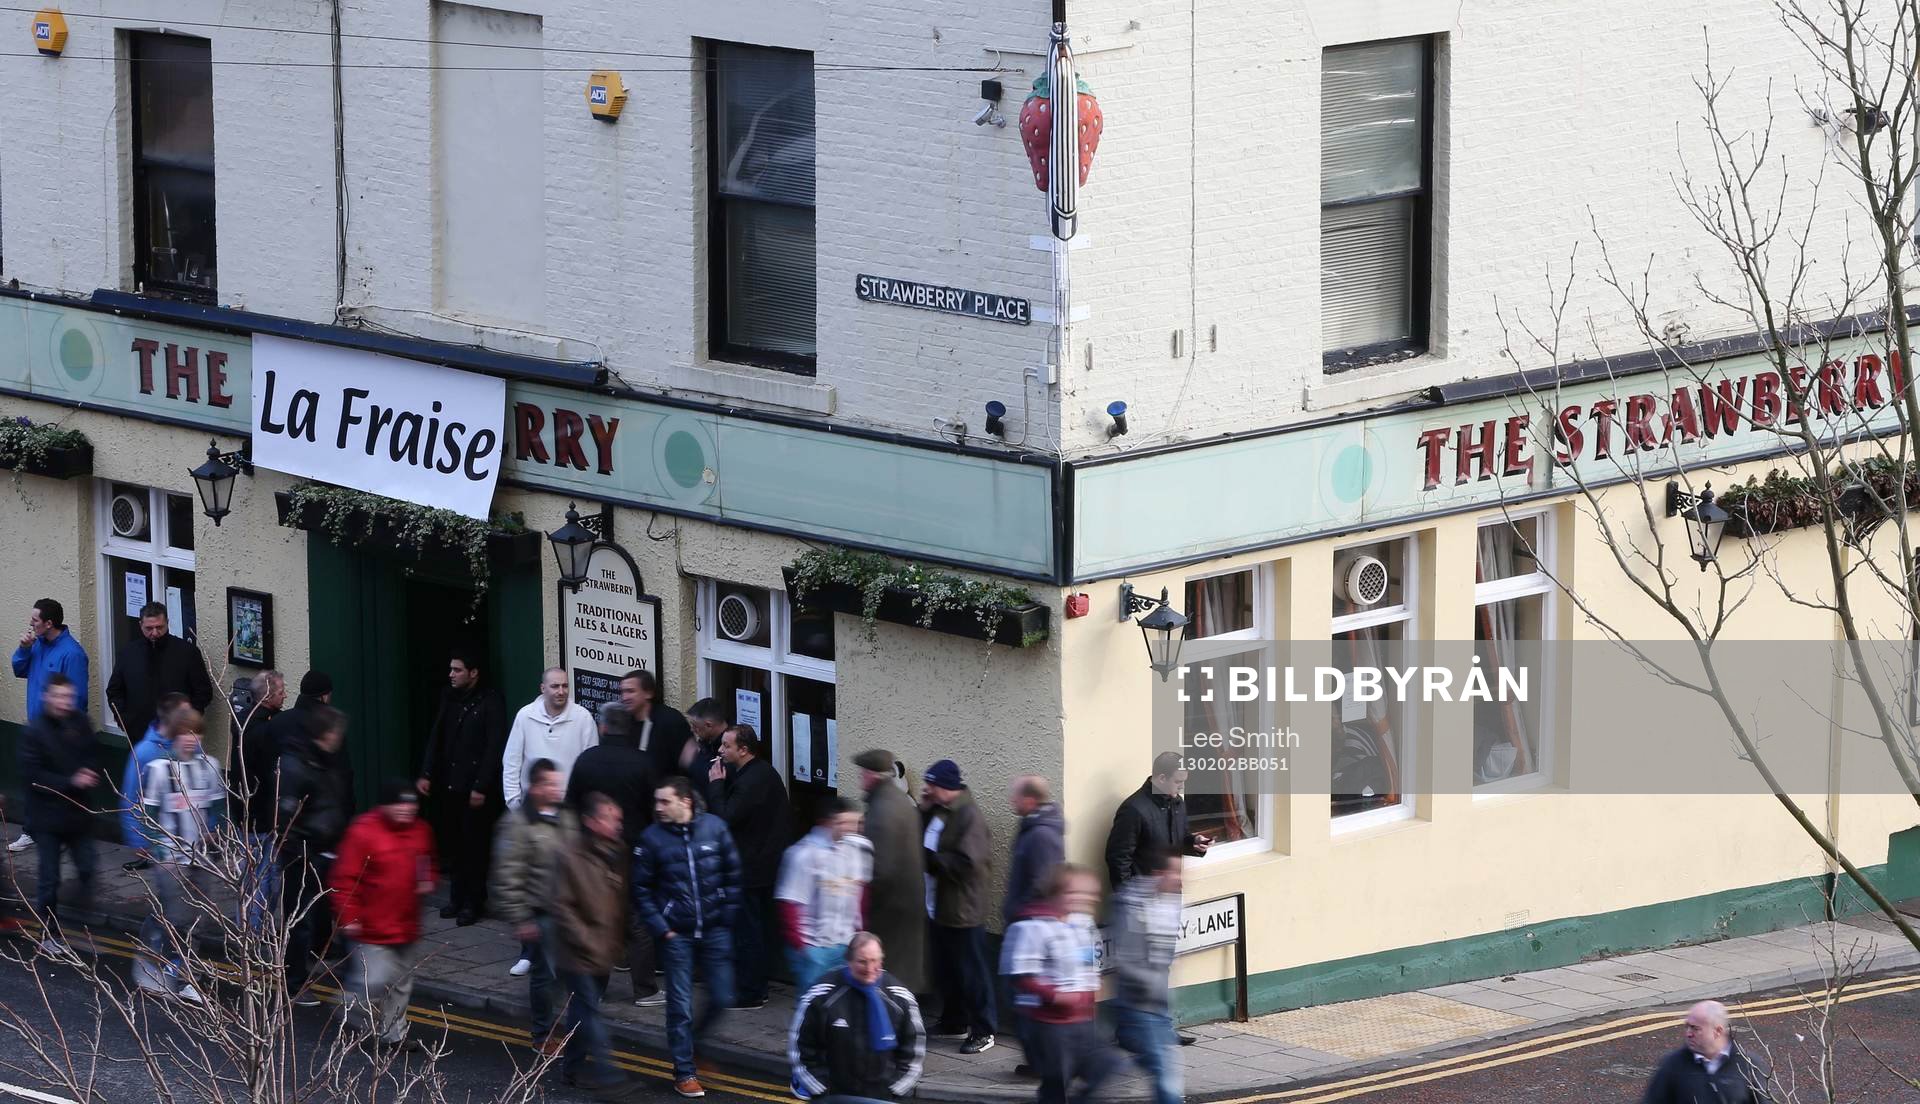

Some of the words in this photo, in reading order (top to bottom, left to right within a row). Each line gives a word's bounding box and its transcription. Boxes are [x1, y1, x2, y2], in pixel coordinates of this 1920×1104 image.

[36, 26, 49, 37] ADT
[591, 89, 606, 101] ADT
[860, 277, 967, 311] STRAWBERRY
[974, 294, 1027, 320] PLACE
[131, 337, 233, 409] THE
[260, 370, 320, 443] La
[336, 387, 496, 481] Fraise
[1416, 414, 1534, 492] THE
[601, 569, 616, 580] THE
[585, 579, 633, 596] STRAWBERRY
[576, 602, 644, 625] TRADITIONAL
[574, 617, 597, 631] ALES
[600, 621, 609, 634] &
[611, 624, 648, 641] LAGERS
[575, 646, 604, 661] FOOD
[606, 652, 625, 666] ALL
[627, 656, 647, 670] DAY
[1198, 909, 1235, 936] LANE
